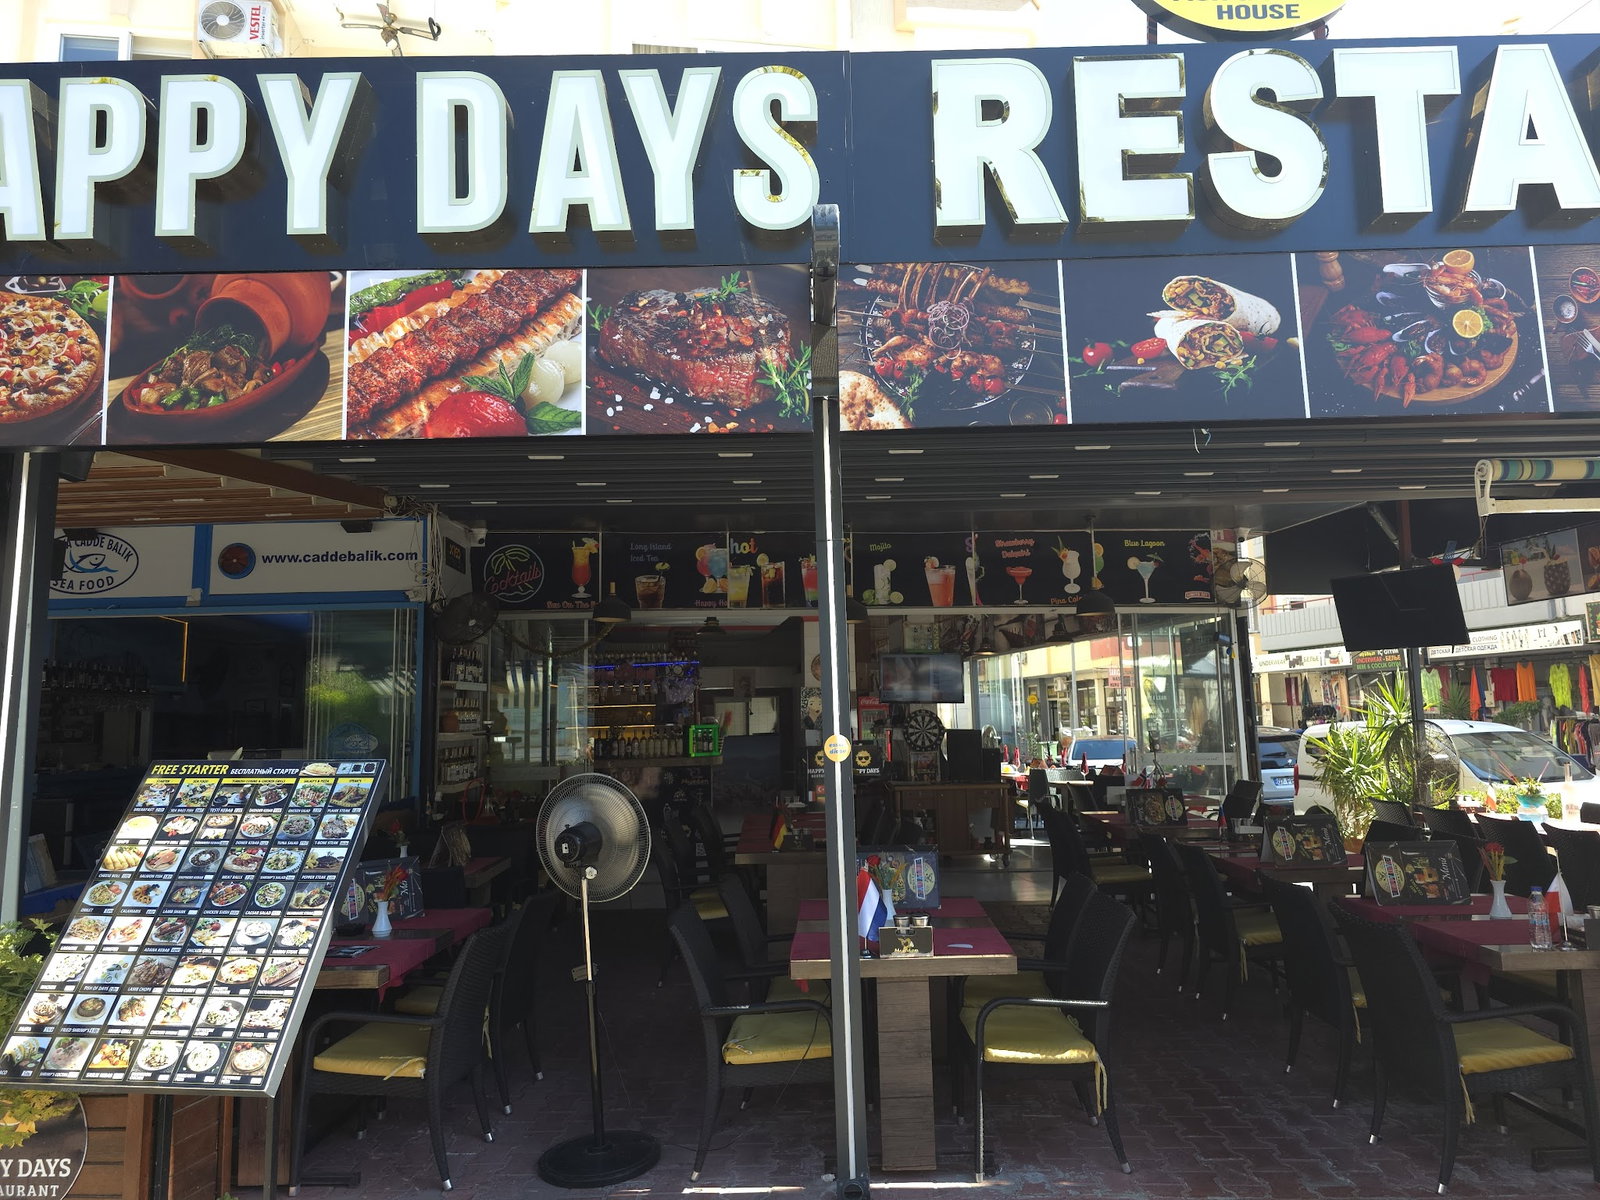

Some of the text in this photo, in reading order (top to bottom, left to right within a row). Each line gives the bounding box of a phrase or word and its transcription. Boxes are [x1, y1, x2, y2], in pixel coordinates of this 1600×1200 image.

[1216, 4, 1301, 20] HOUSE
[249, 5, 261, 40] VESTEL
[416, 65, 821, 235] DAYS
[107, 538, 133, 562] BALIK
[630, 543, 649, 552] Long
[869, 542, 892, 552] Mojito
[1124, 539, 1165, 548] Blue Lagoon
[262, 549, 418, 564] www.caddebalik.com
[79, 576, 114, 590] FOOD
[484, 561, 542, 595] Cocktails
[1472, 634, 1498, 643] CLOTHING
[151, 764, 230, 775] FREE STARTER
[230, 767, 273, 775] БЕСПЛАТНЫЙ
[17, 1158, 71, 1178] DAYS
